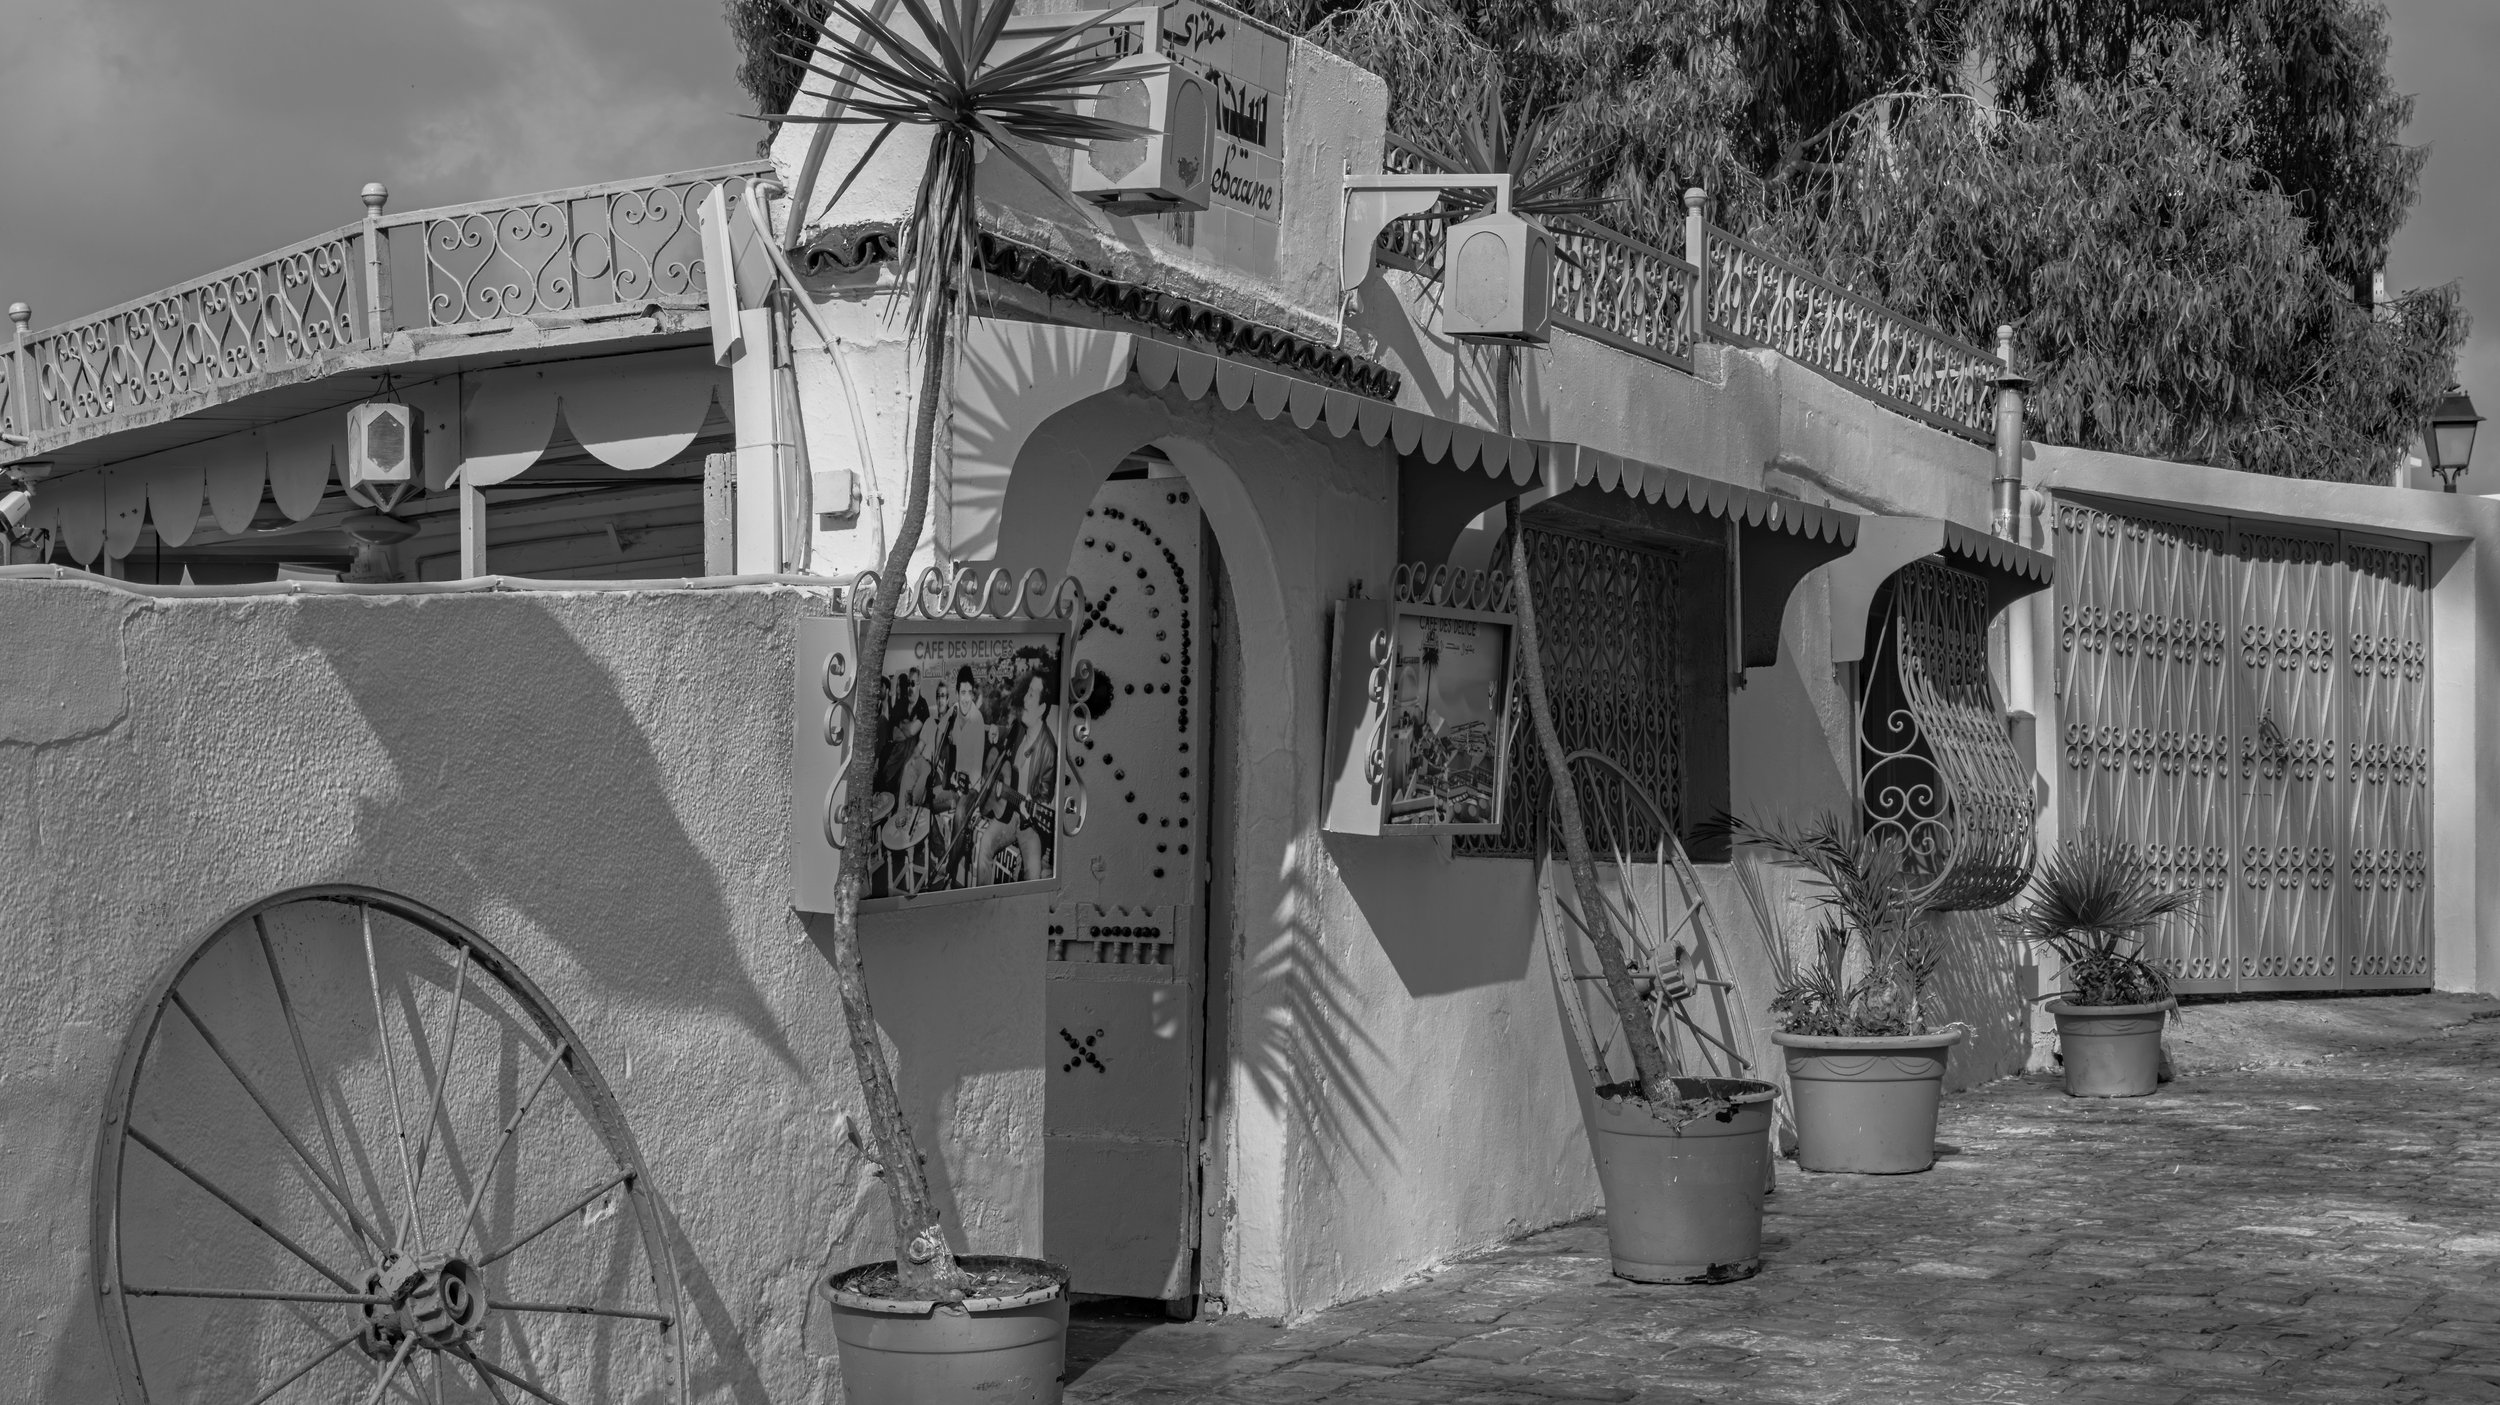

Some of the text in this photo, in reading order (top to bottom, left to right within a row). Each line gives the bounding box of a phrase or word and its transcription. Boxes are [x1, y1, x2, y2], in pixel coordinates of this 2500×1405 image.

[1420, 616, 1437, 631] CAFE
[1440, 618, 1452, 633] DES
[914, 639, 1014, 659] CAFE DES DELICES
